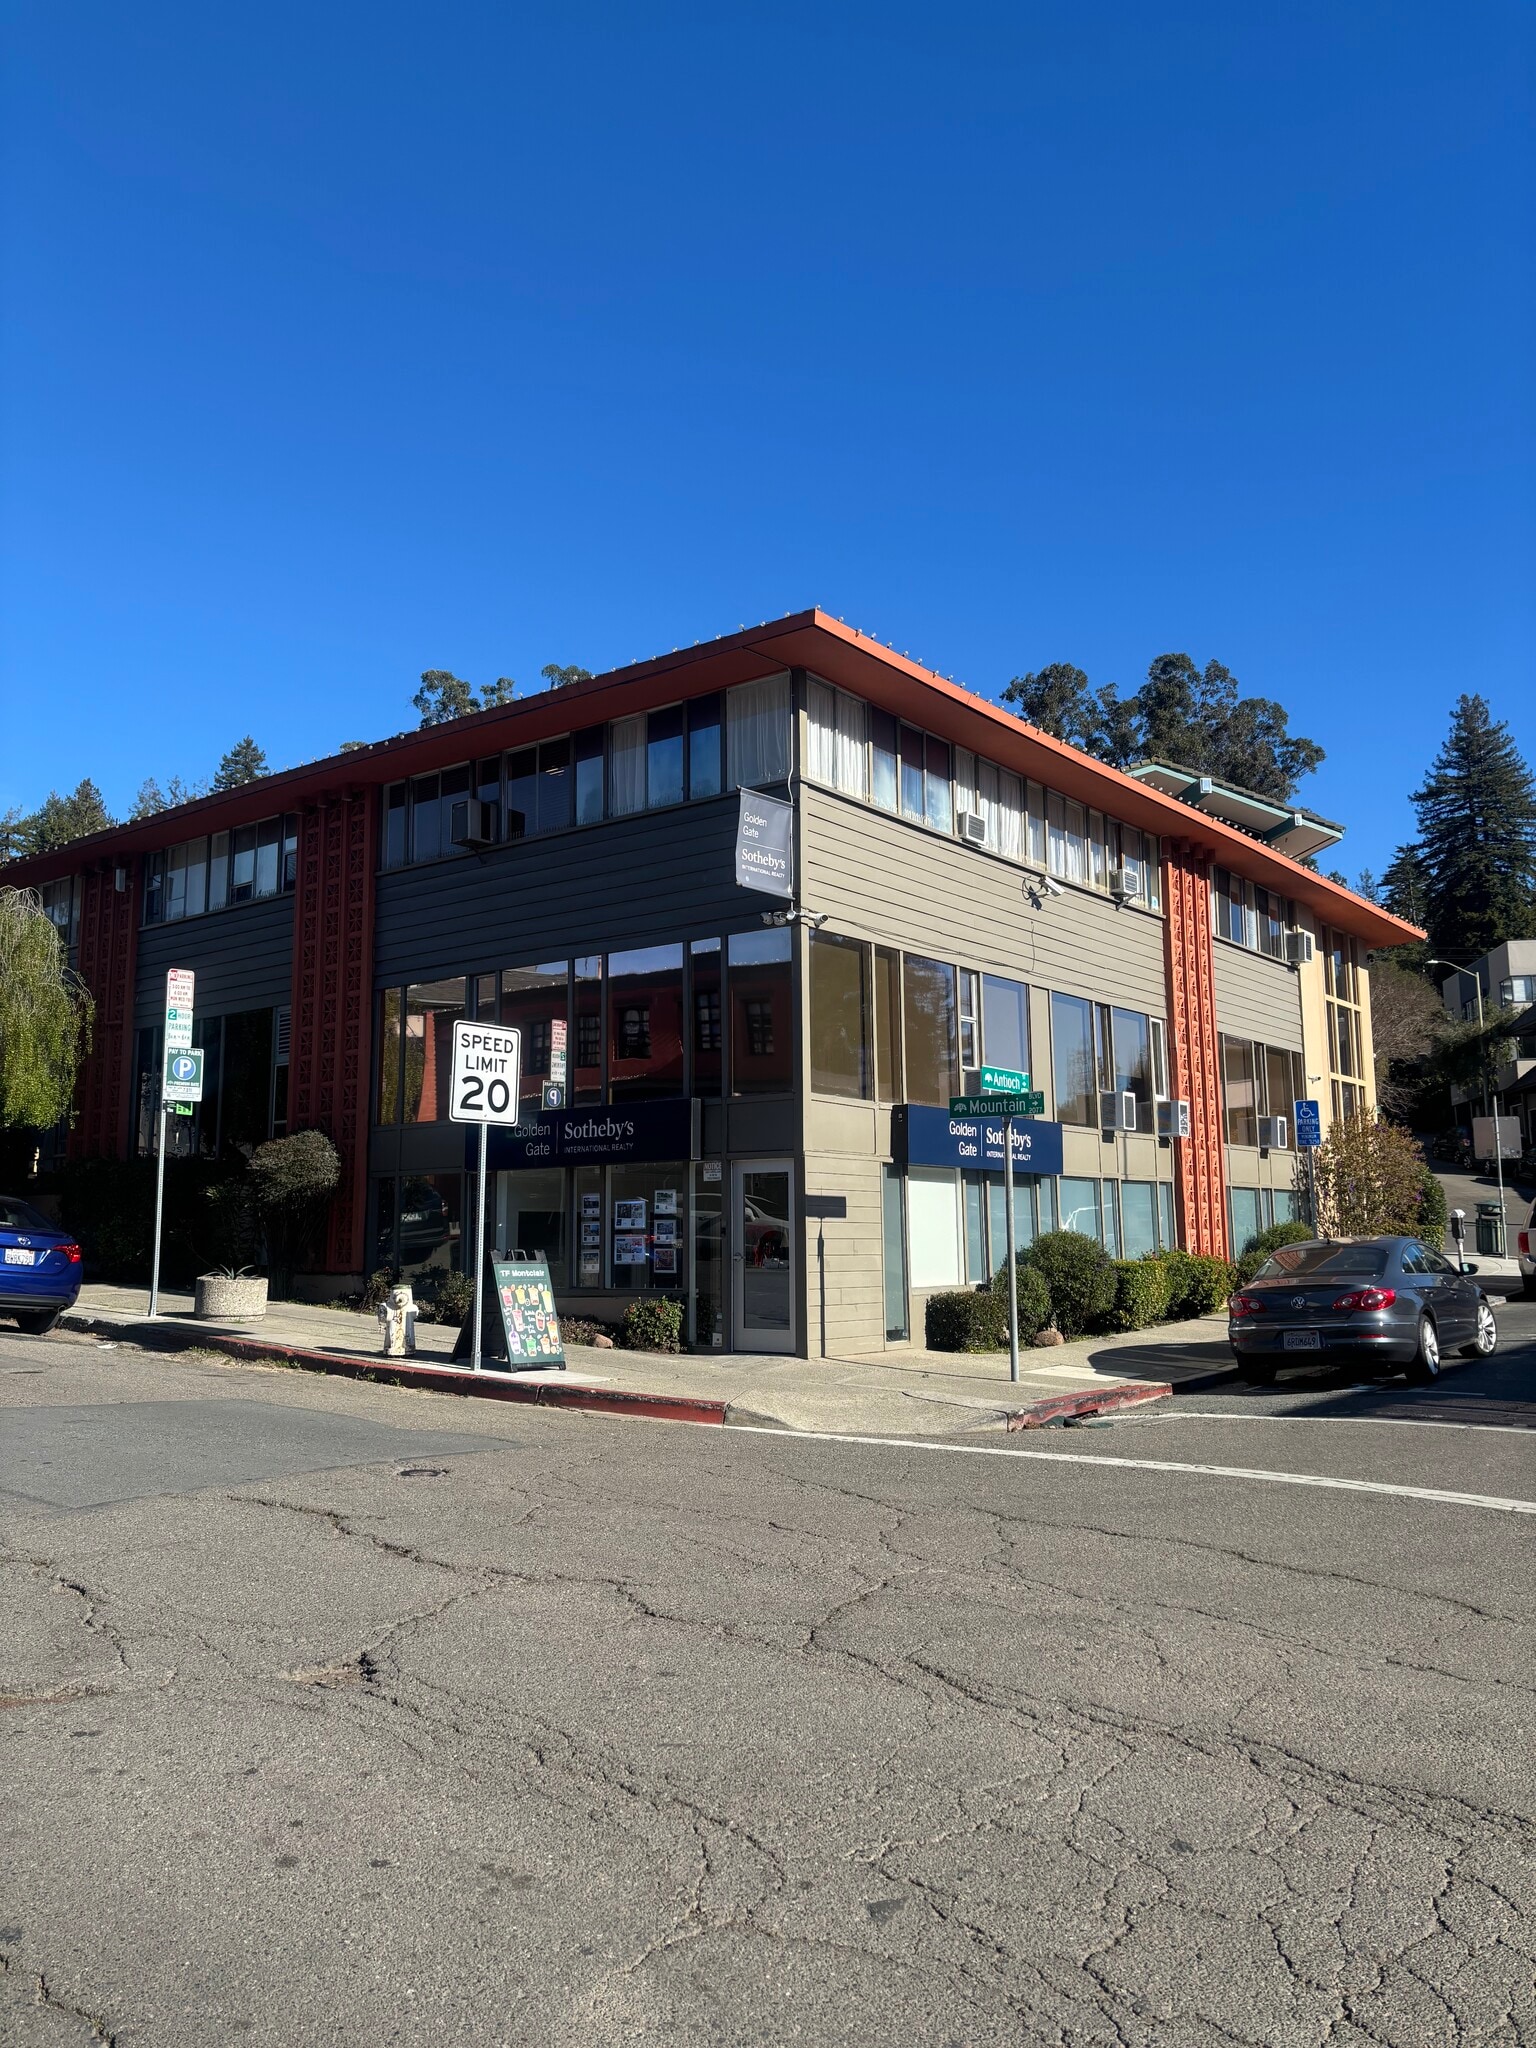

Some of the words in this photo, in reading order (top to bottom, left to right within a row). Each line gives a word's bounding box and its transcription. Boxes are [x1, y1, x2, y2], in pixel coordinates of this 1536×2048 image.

[743, 812, 767, 827] Golden
[742, 825, 759, 838] Gate
[741, 848, 785, 870] Sotheby's
[170, 1010, 176, 1019] 2
[168, 1022, 191, 1031] PARKING
[461, 1033, 513, 1054] SPEED
[179, 1058, 192, 1078] P
[465, 1054, 508, 1073] LIMIT
[993, 1072, 1020, 1090] Antioch
[460, 1075, 510, 1113] 20
[969, 1097, 1026, 1114] Mountain
[1028, 1106, 1042, 1114] 2077
[514, 1122, 550, 1137] Golden
[564, 1117, 634, 1140] Sotheby's
[949, 1120, 977, 1136] Golden
[986, 1127, 1032, 1151] Soteby's
[525, 1142, 550, 1156] Gate
[564, 1144, 611, 1154] INTERNATIONAL
[611, 1142, 634, 1151] REALTY
[958, 1141, 977, 1157] Gate
